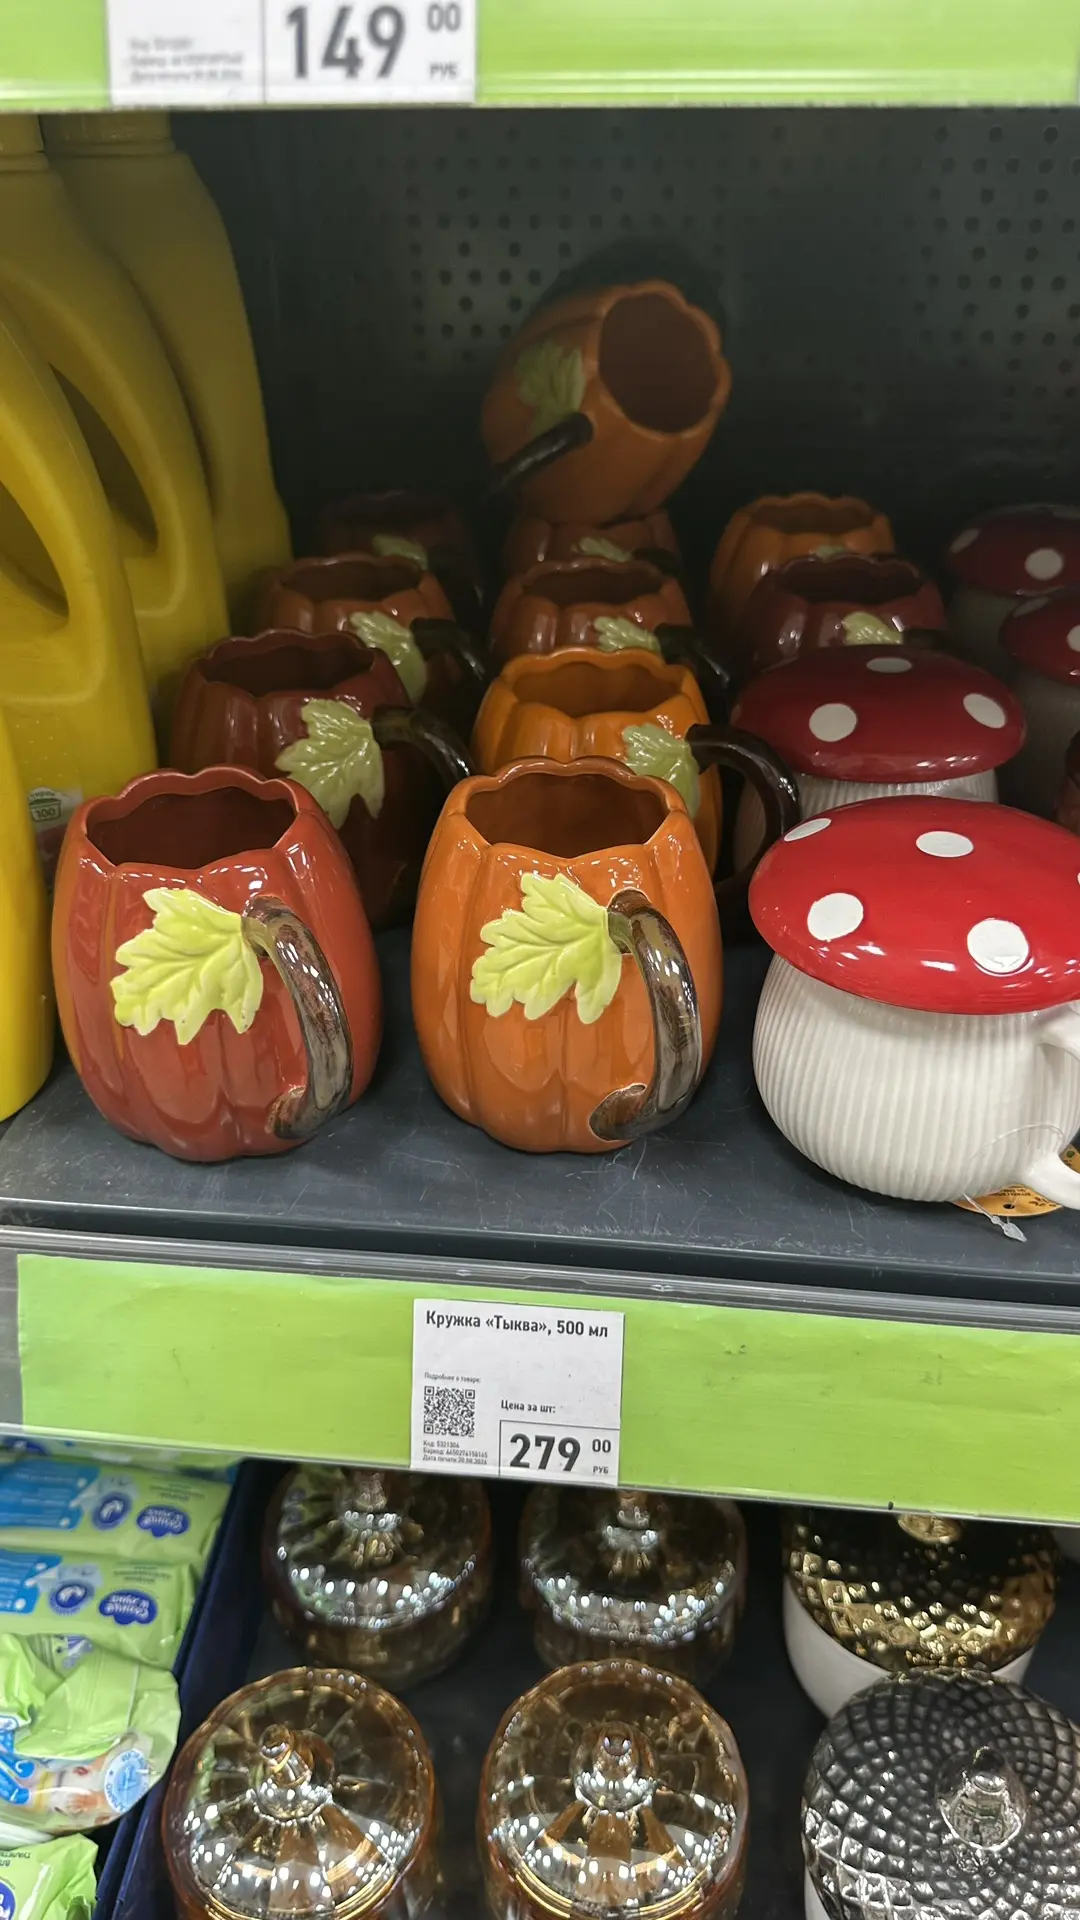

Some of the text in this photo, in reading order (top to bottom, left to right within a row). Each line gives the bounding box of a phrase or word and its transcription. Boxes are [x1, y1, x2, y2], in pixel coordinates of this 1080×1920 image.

[426, 3, 462, 32] 00
[285, 5, 406, 79] 149
[429, 62, 459, 78] РУБ
[426, 1310, 608, 1338] Кружка «Тыква», 500 мл
[501, 1399, 556, 1413] Цена за шт:
[510, 1433, 581, 1472] 279
[592, 1439, 611, 1453] 00
[592, 1465, 609, 1475] РУБ
